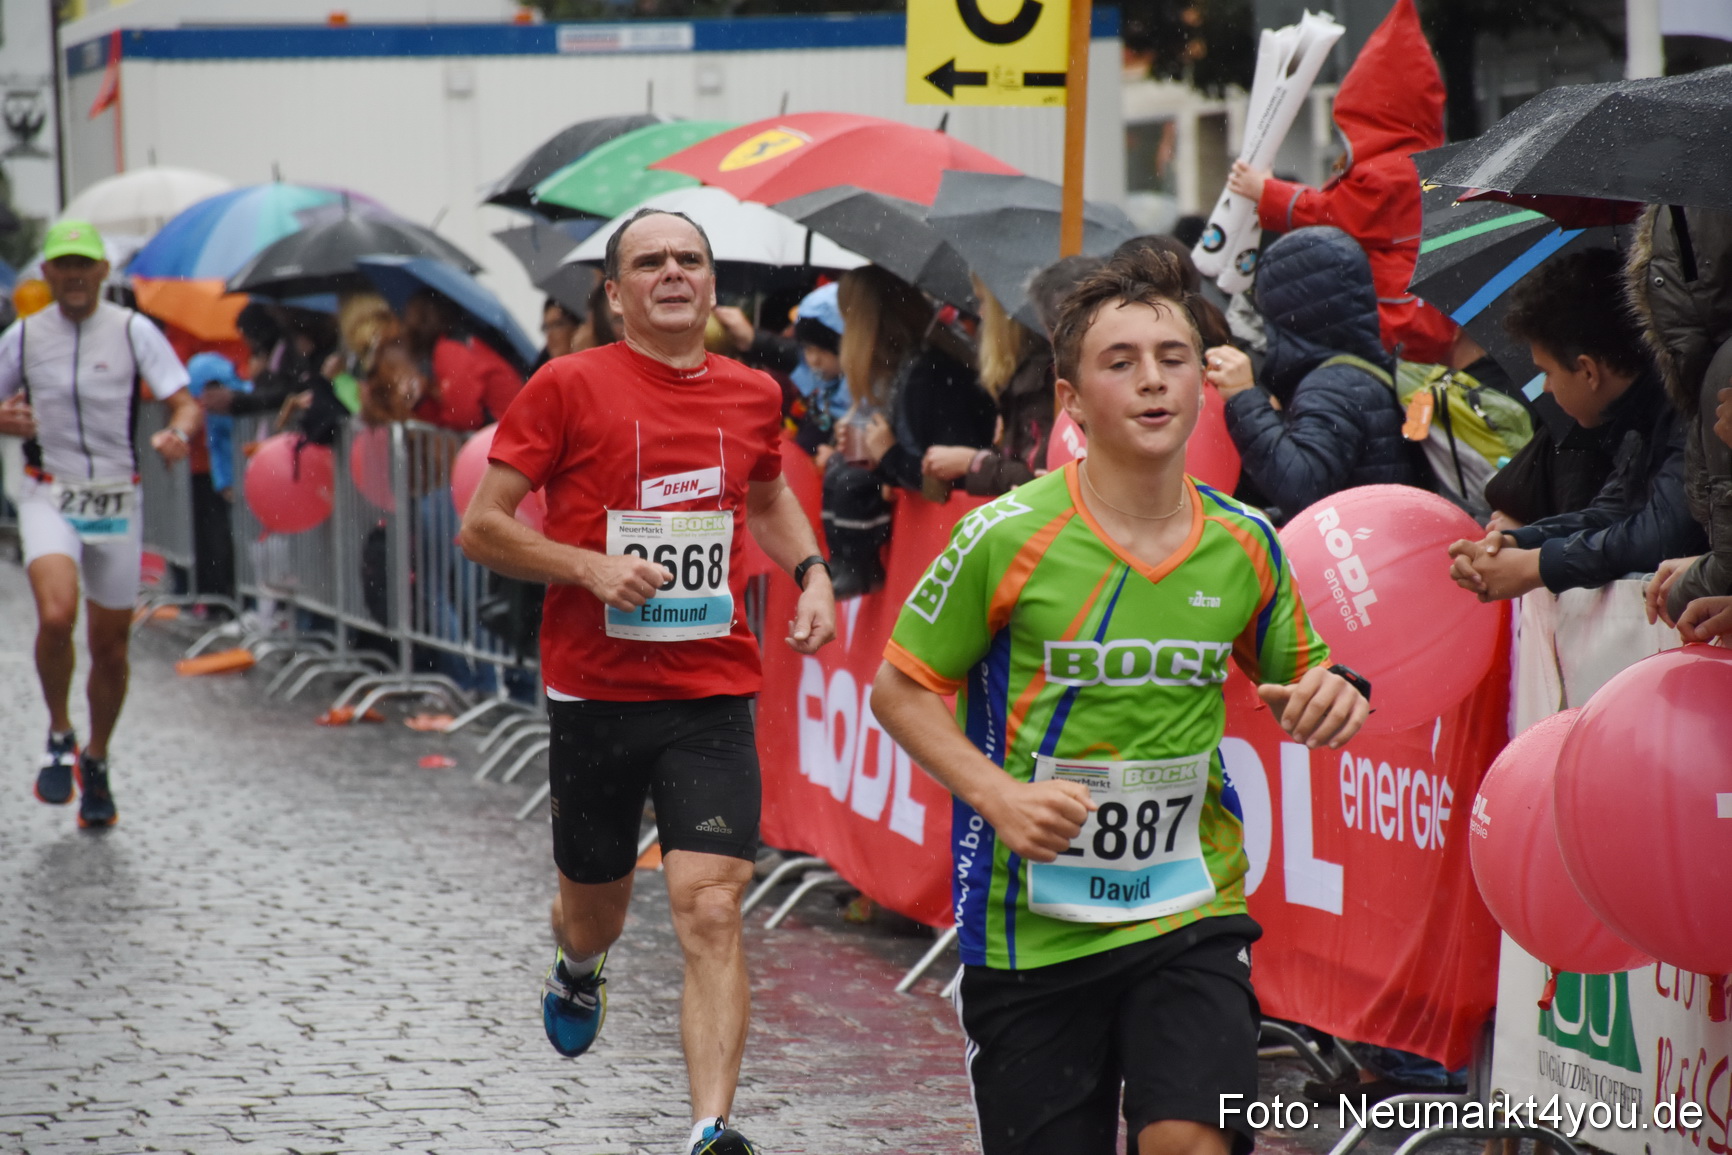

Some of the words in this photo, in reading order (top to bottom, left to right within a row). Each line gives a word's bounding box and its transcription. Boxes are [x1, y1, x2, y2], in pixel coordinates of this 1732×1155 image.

[663, 479, 699, 497] DEHN
[619, 526, 663, 534] NeuerMarkt
[671, 516, 726, 532] BOCK
[905, 494, 1034, 624] BOCK
[641, 603, 708, 622] Edmund
[1044, 638, 1233, 687] BOCK
[1123, 761, 1198, 787] BOCK
[696, 825, 733, 834] adidas
[1057, 794, 1194, 861] 887
[1090, 876, 1150, 902] David
